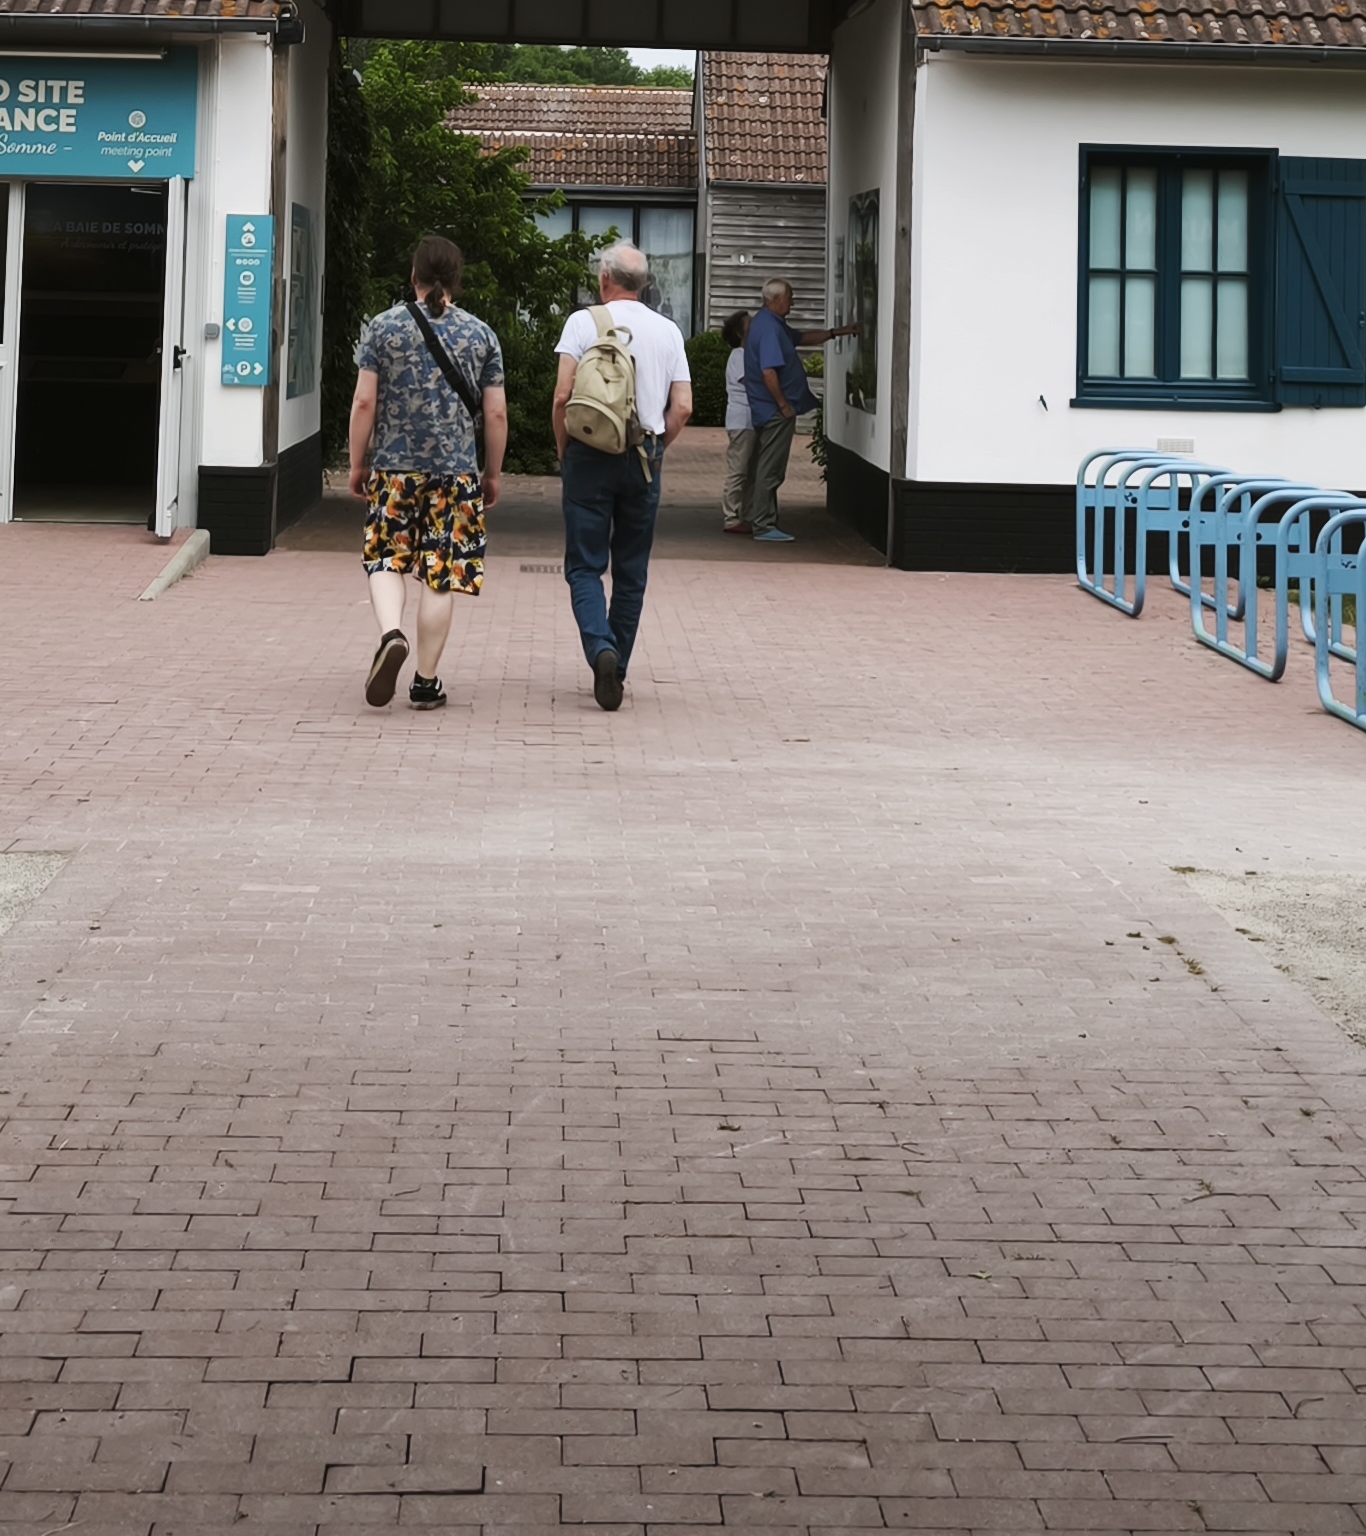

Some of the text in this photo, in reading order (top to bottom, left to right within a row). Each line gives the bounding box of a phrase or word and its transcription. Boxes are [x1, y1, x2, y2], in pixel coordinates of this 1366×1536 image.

[18, 79, 85, 104] SITE
[98, 131, 126, 142] Point
[101, 146, 173, 159] meeting point
[66, 221, 98, 233] BAIE
[102, 222, 121, 234] DE
